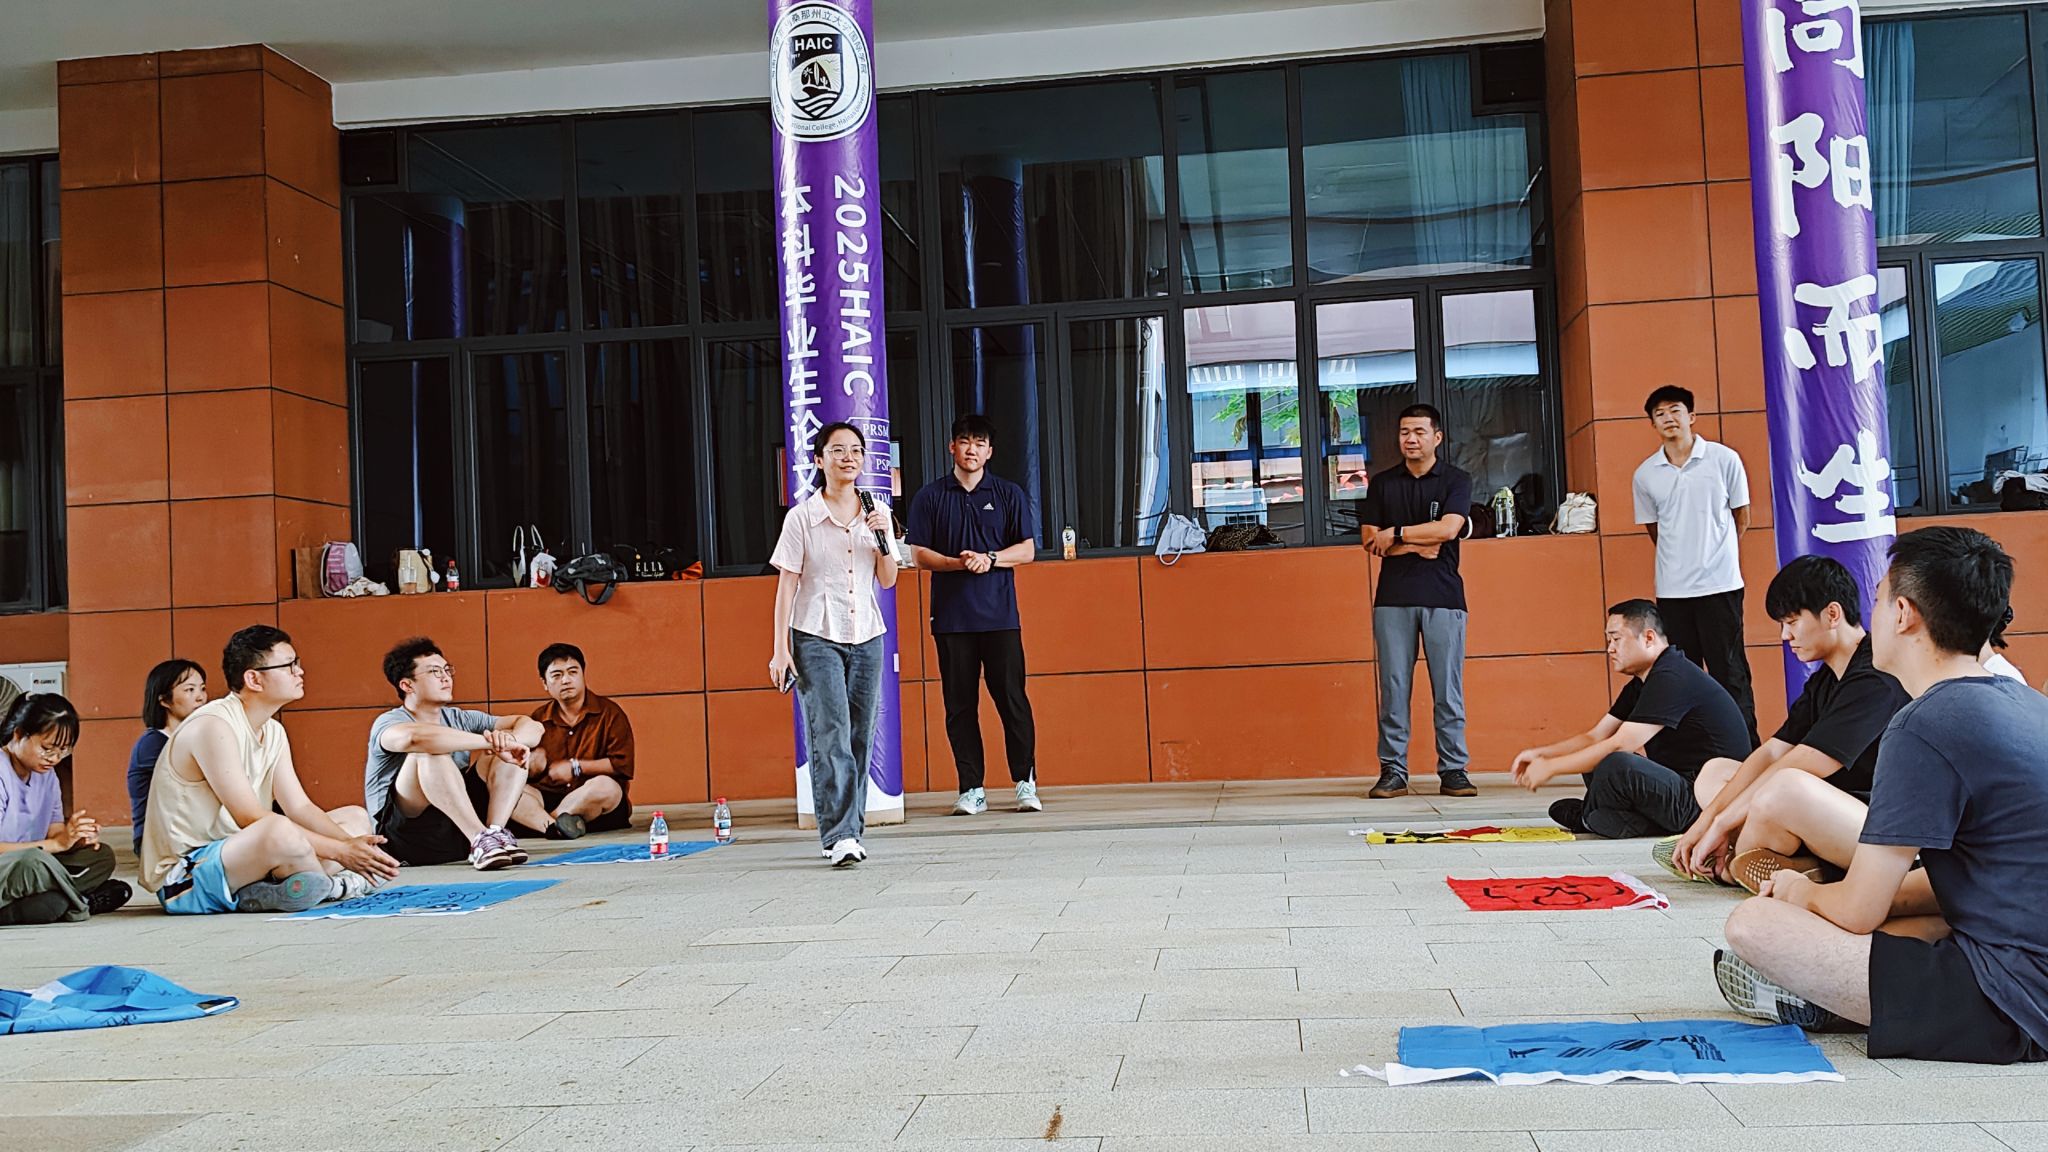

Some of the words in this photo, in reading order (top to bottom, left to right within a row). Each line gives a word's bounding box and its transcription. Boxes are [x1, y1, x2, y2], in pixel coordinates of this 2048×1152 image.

[795, 37, 833, 51] HAIC
[781, 185, 823, 499] 本科毕业生论文
[834, 175, 875, 397] 2025HAIC
[1766, 0, 1897, 543] 向阳而生
